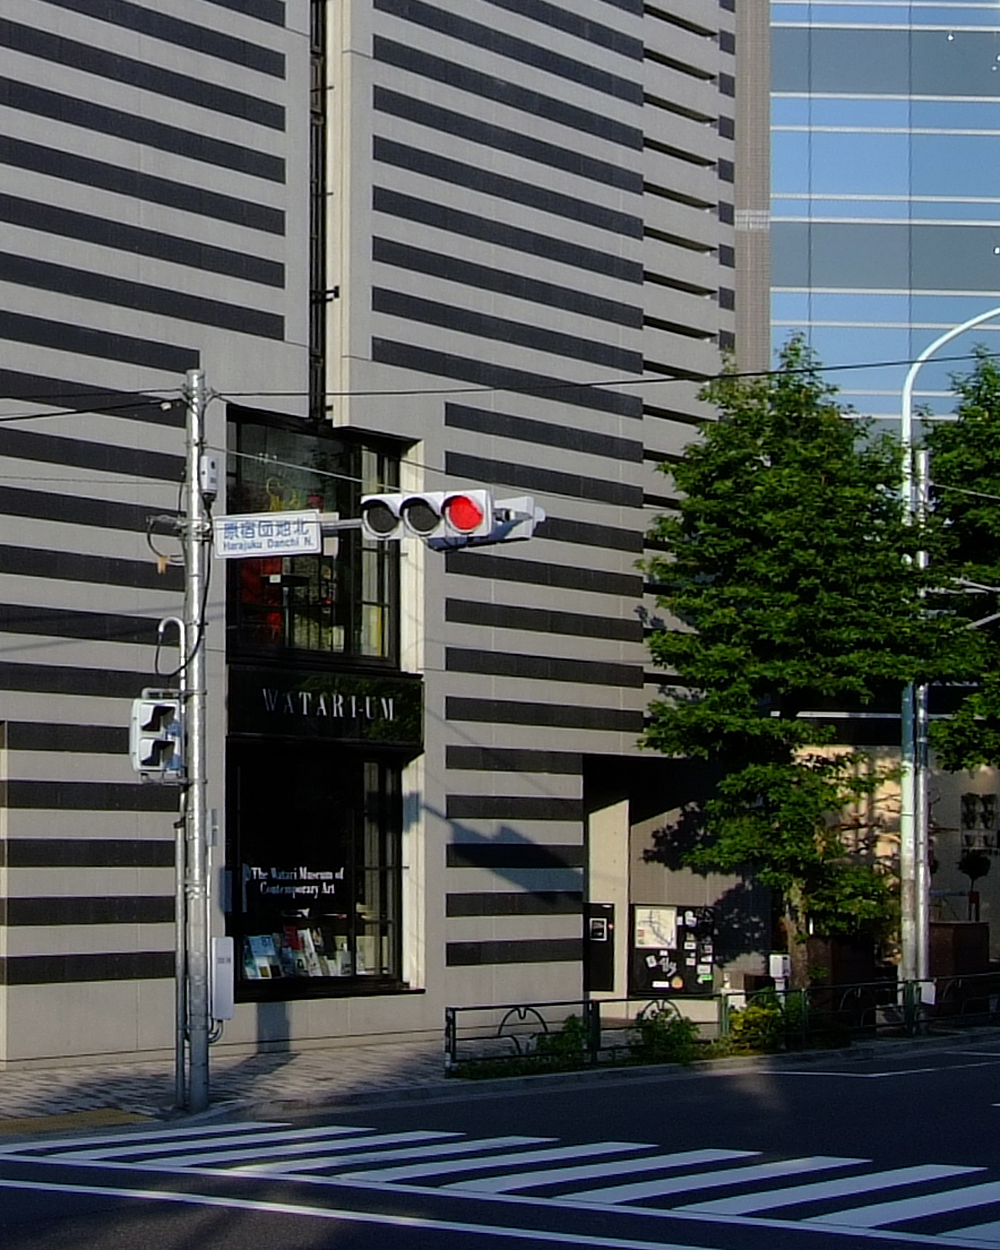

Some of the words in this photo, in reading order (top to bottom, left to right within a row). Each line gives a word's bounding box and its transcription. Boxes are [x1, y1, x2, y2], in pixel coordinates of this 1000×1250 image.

[223, 518, 309, 539] 原宿団地北
[223, 540, 263, 551] Harajuku
[267, 538, 300, 548] Danchi
[251, 866, 269, 880] The
[270, 867, 297, 880] Watari
[299, 866, 334, 880] Museum
[335, 867, 344, 880] of
[260, 881, 320, 899] Contemporary
[321, 881, 335, 894] Art
